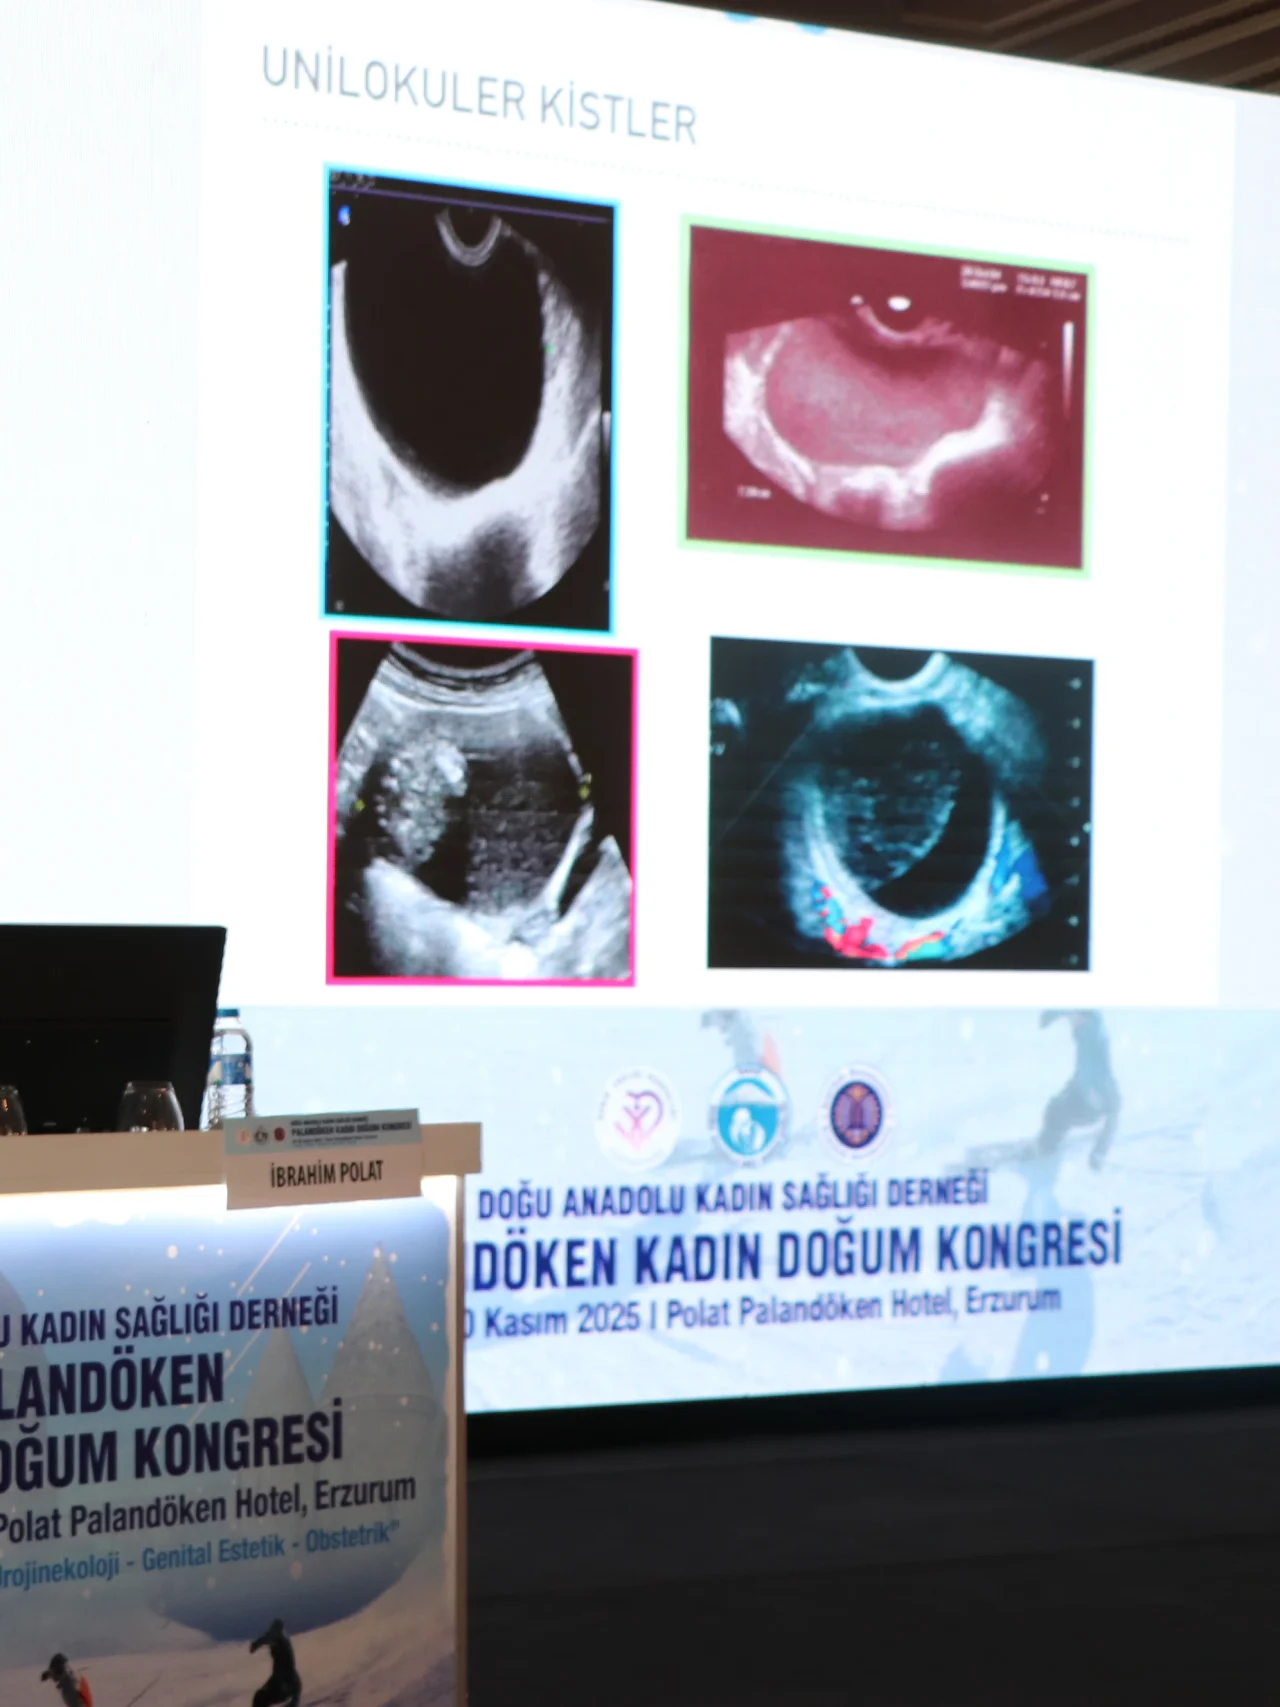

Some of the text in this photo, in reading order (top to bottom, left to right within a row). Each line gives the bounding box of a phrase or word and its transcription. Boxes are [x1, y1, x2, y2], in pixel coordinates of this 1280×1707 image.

[263, 44, 698, 144] UNİLOKULER KİSTLER
[271, 1159, 384, 1188] İBRAHİM POLAT
[479, 1167, 989, 1219] DOĞU ANADOLU KADIN SAĞLIĞI DERNEĞİ
[472, 1206, 1123, 1291] DÖKEN KADIN DOĞUM KONGRESİ
[21, 1308, 106, 1346] KADIN
[115, 1292, 219, 1340] SAĞLIĞI
[229, 1285, 338, 1331] DERNEĞİ
[485, 1307, 568, 1338] Kasım
[578, 1301, 641, 1333] 2025
[666, 1297, 730, 1329] Polat
[739, 1291, 882, 1327] Palandöken
[891, 1286, 958, 1320] Hotel,
[966, 1285, 1062, 1314] Erzurum
[134, 1397, 343, 1480] KONGRESİ
[70, 1494, 227, 1537] Palandöken
[236, 1483, 308, 1519] Hotel,
[314, 1476, 416, 1511] Erzurum
[142, 1541, 212, 1573] Genital
[219, 1533, 286, 1564] Estetik
